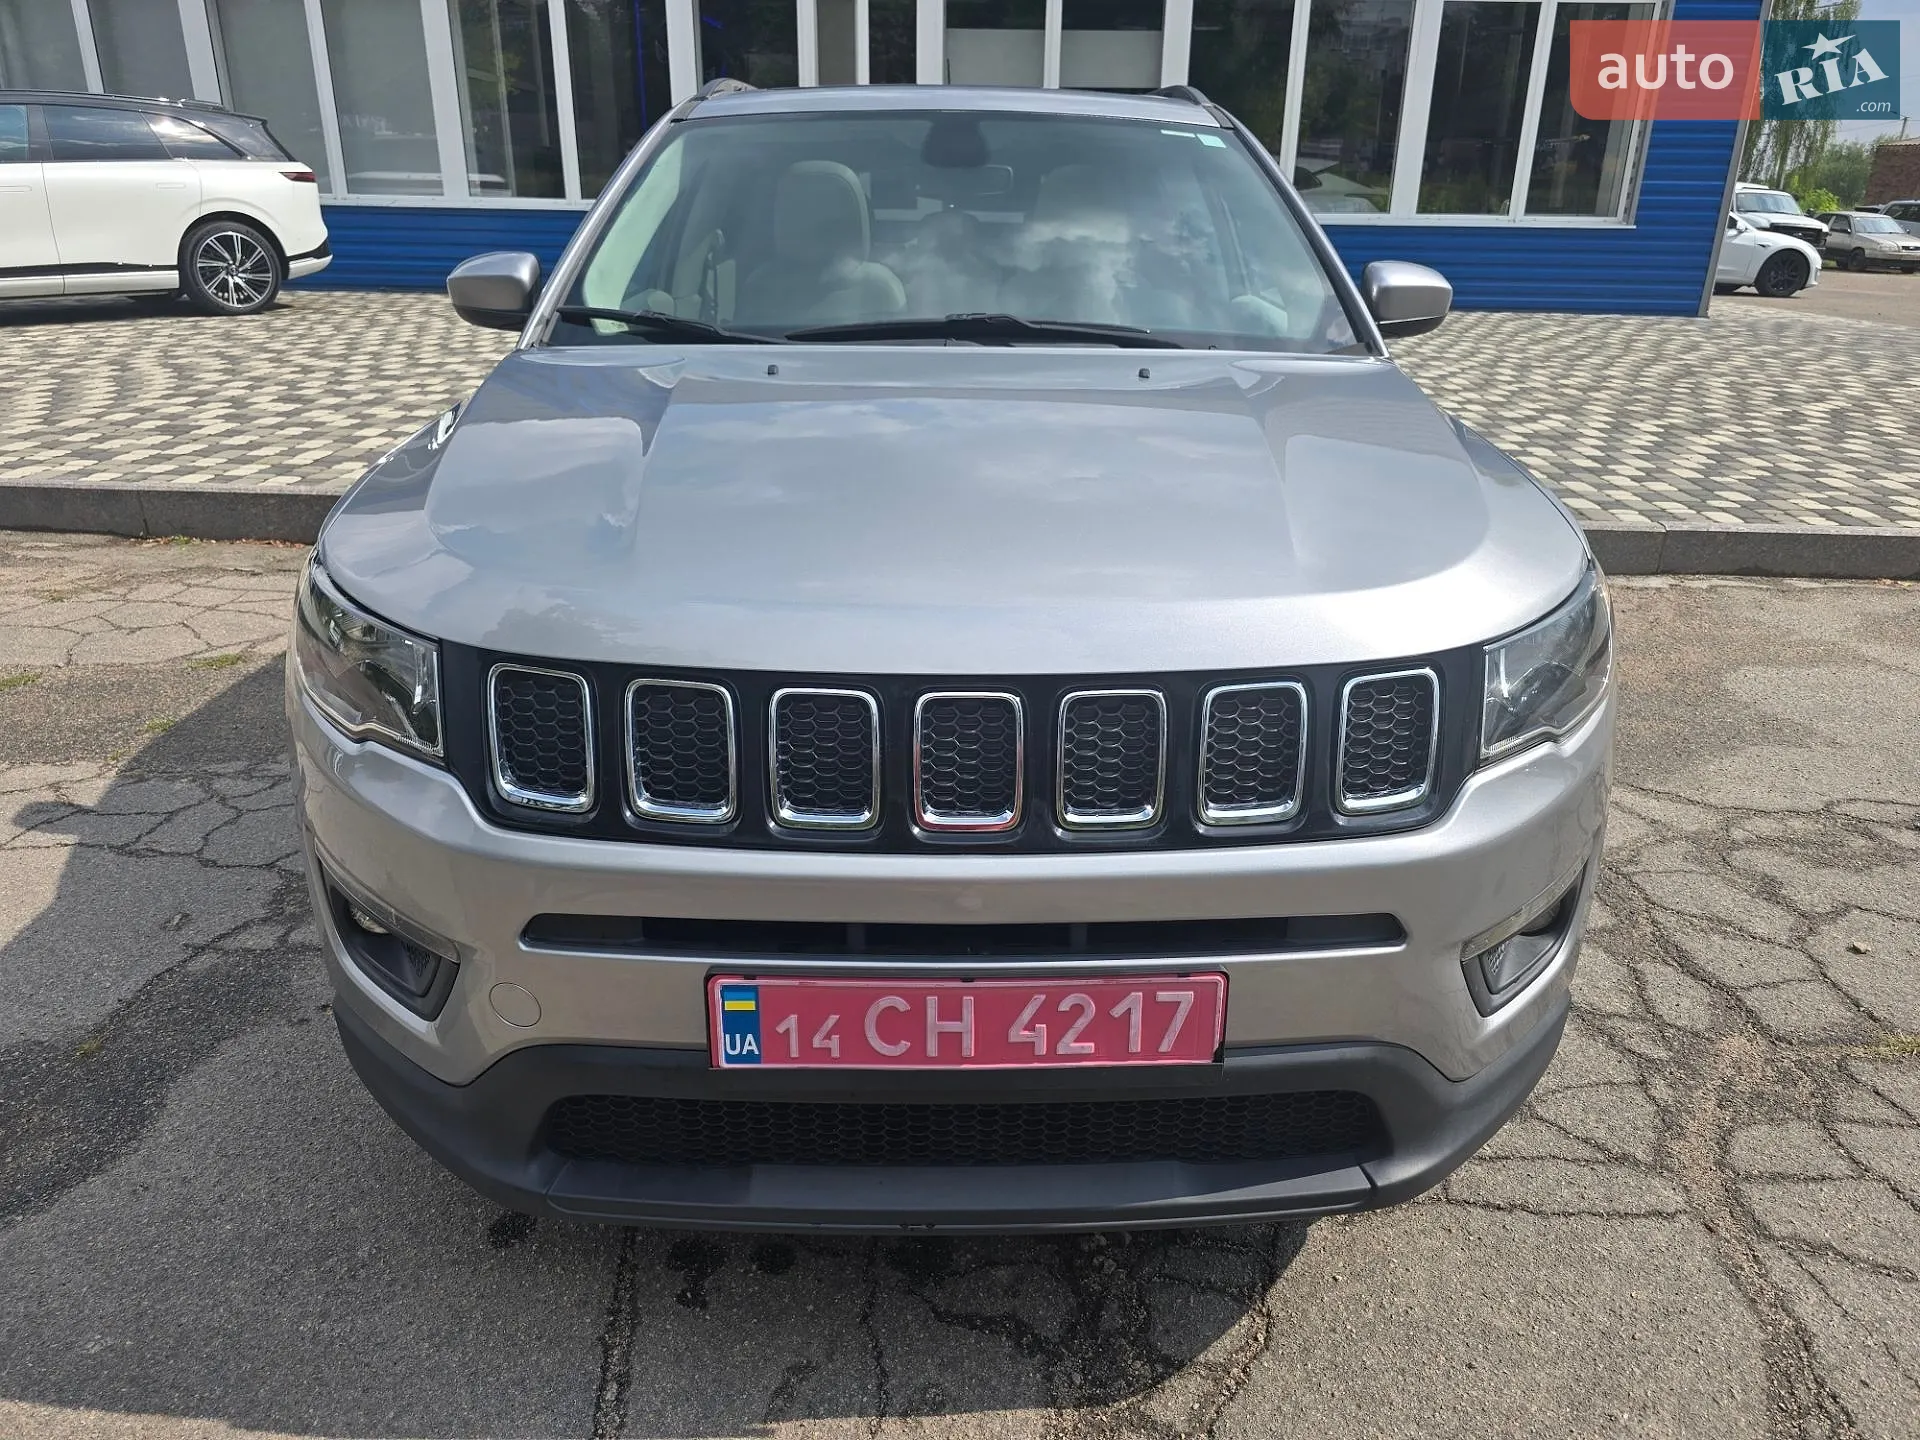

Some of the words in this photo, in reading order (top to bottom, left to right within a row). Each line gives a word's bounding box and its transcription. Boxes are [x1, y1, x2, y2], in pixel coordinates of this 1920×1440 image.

[725, 1033, 760, 1056] UA
[775, 1014, 841, 1058] 14
[864, 995, 975, 1058] CH
[1008, 991, 1196, 1056] 4217
